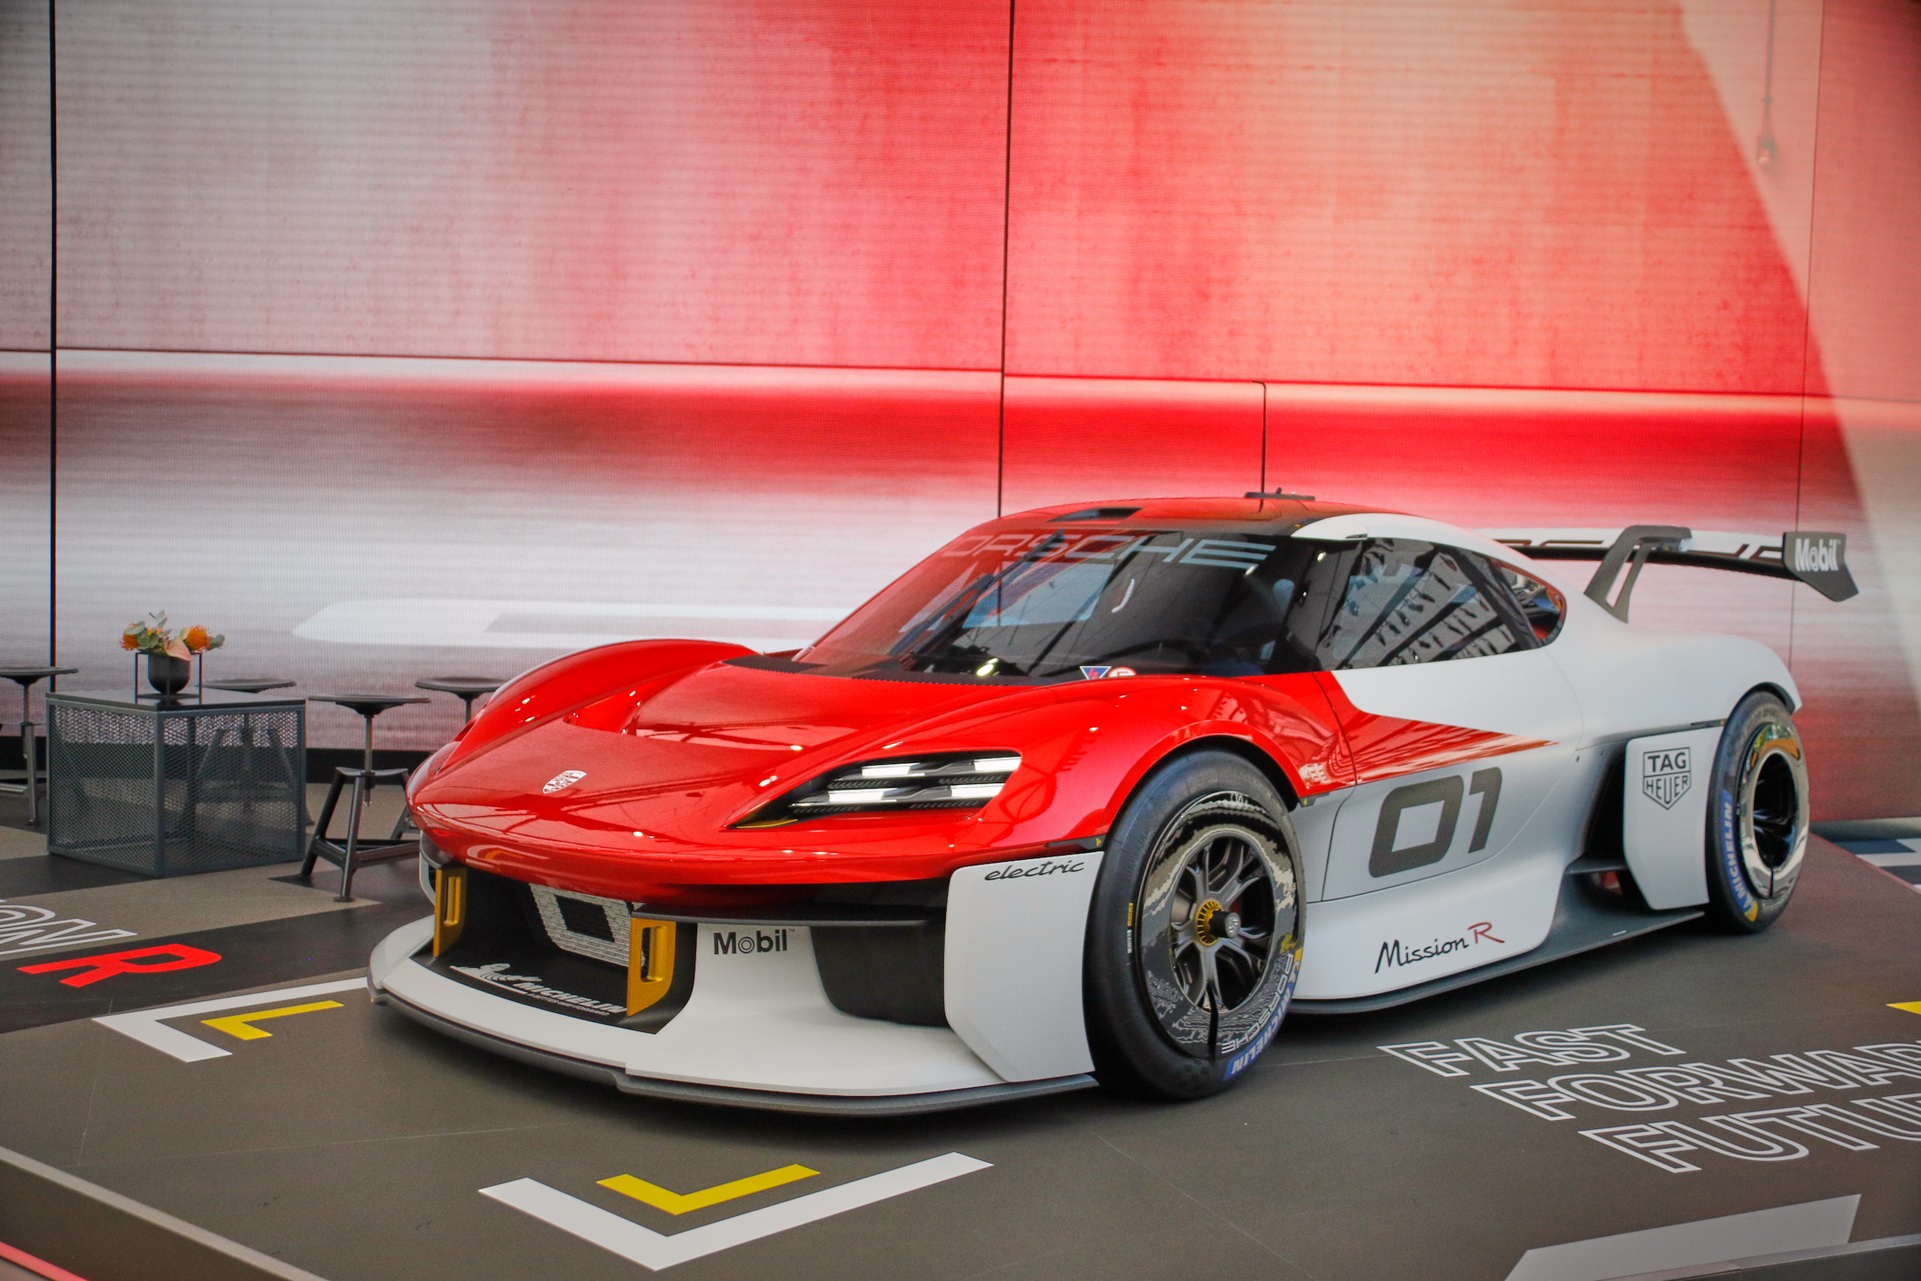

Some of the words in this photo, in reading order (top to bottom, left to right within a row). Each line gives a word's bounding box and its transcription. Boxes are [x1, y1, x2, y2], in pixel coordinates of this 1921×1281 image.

[941, 533, 1276, 570] ORSCHE
[1795, 538, 1839, 571] Mobil
[1647, 752, 1686, 772] TAG
[1646, 775, 1688, 804] HEUER
[1368, 766, 1503, 878] 01
[984, 860, 1084, 881] electric
[1724, 802, 1747, 899] MICHELIN
[713, 929, 787, 955] Mobil
[1374, 938, 1468, 974] Mission
[1467, 921, 1505, 944] R
[16, 943, 222, 988] R
[512, 982, 628, 1014] MICHELIN
[1221, 953, 1294, 1054] PORSCHE
[1231, 986, 1293, 1075] MICHELIN
[1376, 1023, 1687, 1078] FAST
